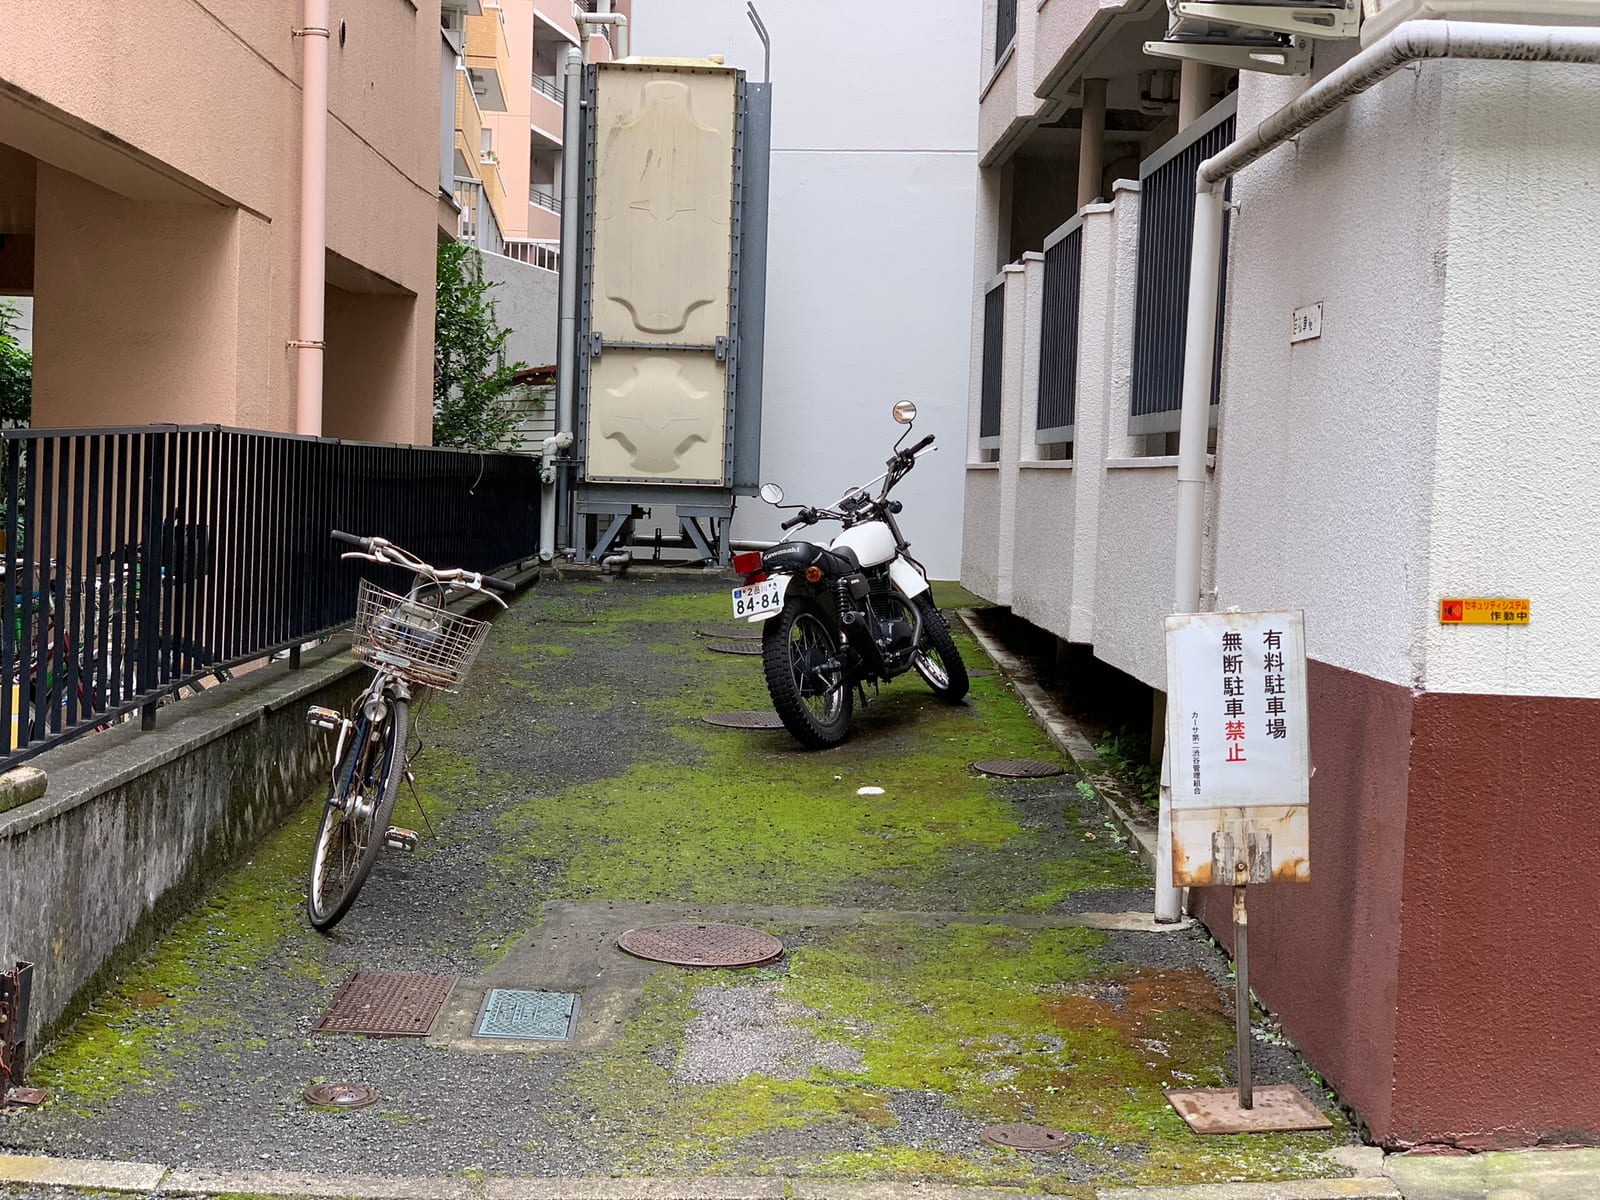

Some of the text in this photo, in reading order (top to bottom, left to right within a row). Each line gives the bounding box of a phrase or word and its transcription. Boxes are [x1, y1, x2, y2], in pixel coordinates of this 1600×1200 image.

[737, 591, 780, 615] 84-84
[1464, 601, 1528, 610] セキュリティシステム
[1490, 611, 1528, 621] 作動中
[1222, 631, 1247, 763] 無断駐車禁止
[1263, 629, 1287, 739] 有料駐車場
[1191, 711, 1202, 795] カーサ第二渋谷管理組合
